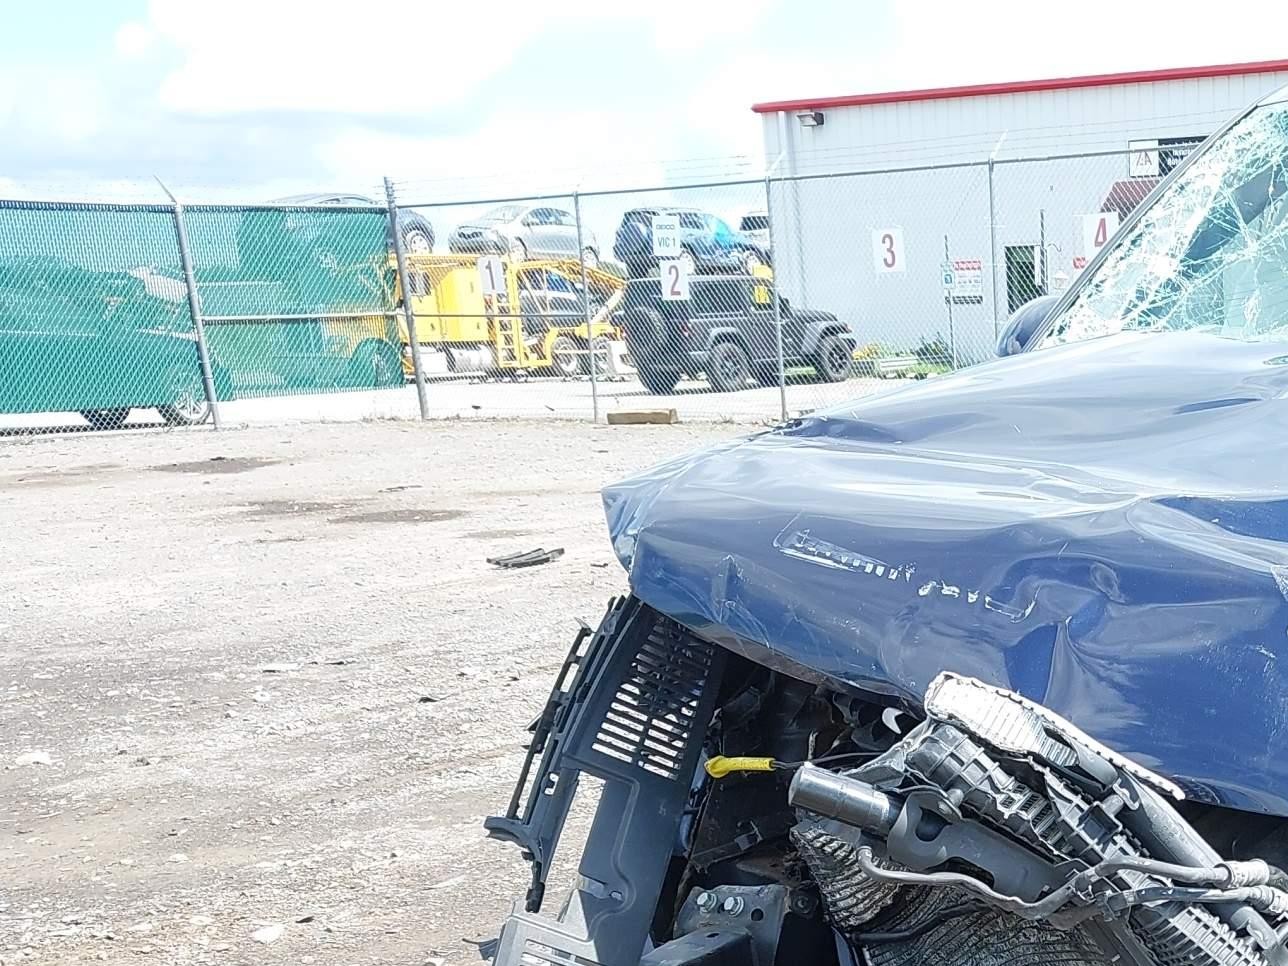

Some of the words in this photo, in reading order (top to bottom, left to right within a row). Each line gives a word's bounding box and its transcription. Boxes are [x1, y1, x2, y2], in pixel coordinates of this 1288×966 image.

[657, 236, 670, 248] VIC
[672, 237, 676, 248] 1
[1094, 217, 1107, 247] 4
[881, 233, 896, 268] 3
[485, 260, 495, 290] 1
[668, 264, 682, 296] 2
